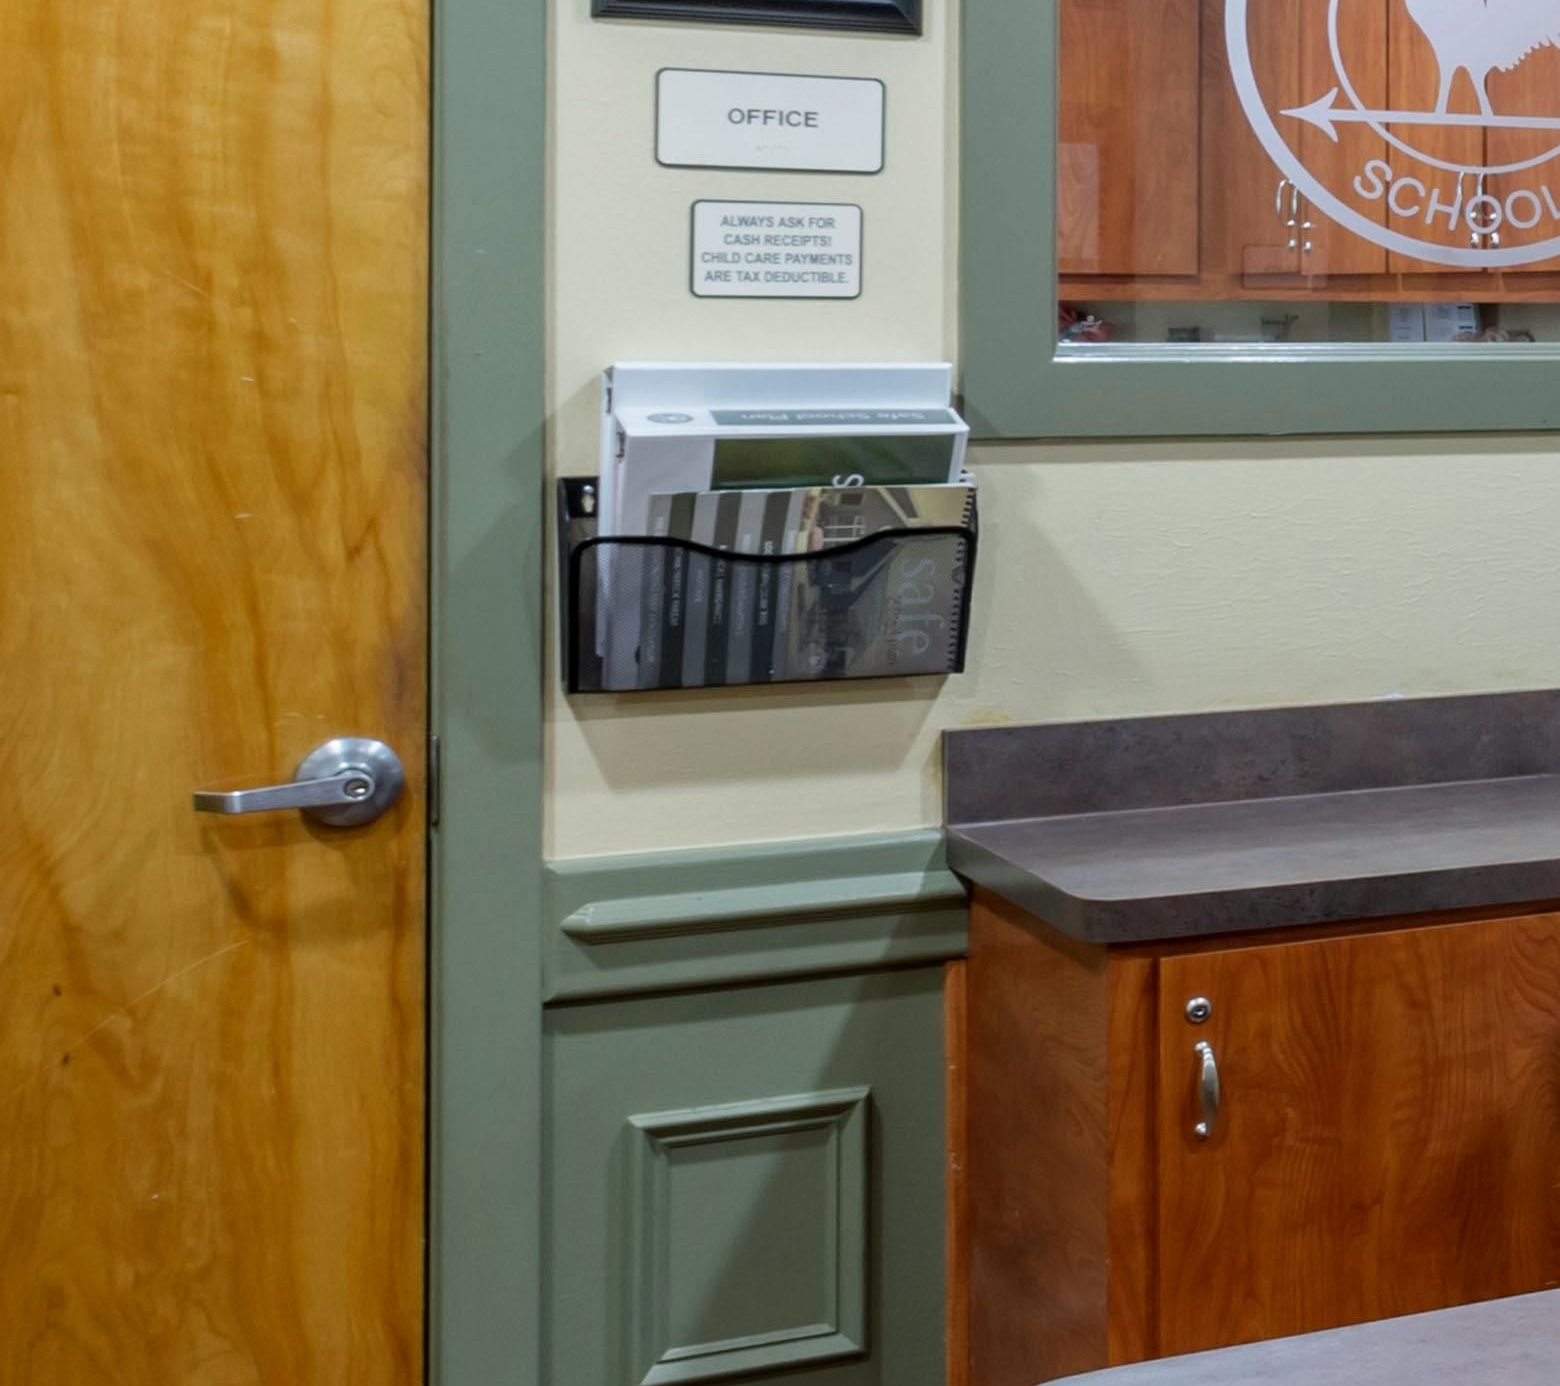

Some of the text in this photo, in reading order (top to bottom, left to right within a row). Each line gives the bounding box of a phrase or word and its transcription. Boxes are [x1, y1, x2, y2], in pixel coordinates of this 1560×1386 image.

[727, 108, 819, 128] OFFICE
[720, 216, 836, 229] ALWAYS ASK FOR
[723, 234, 832, 247] CASH RECEIPTS!
[701, 252, 853, 266] CHILD CARE PAYMENTS
[704, 271, 849, 284] ARE TAX DEDUCTIBLE.
[741, 412, 925, 421] Safe School Plan
[897, 558, 945, 655] safe
